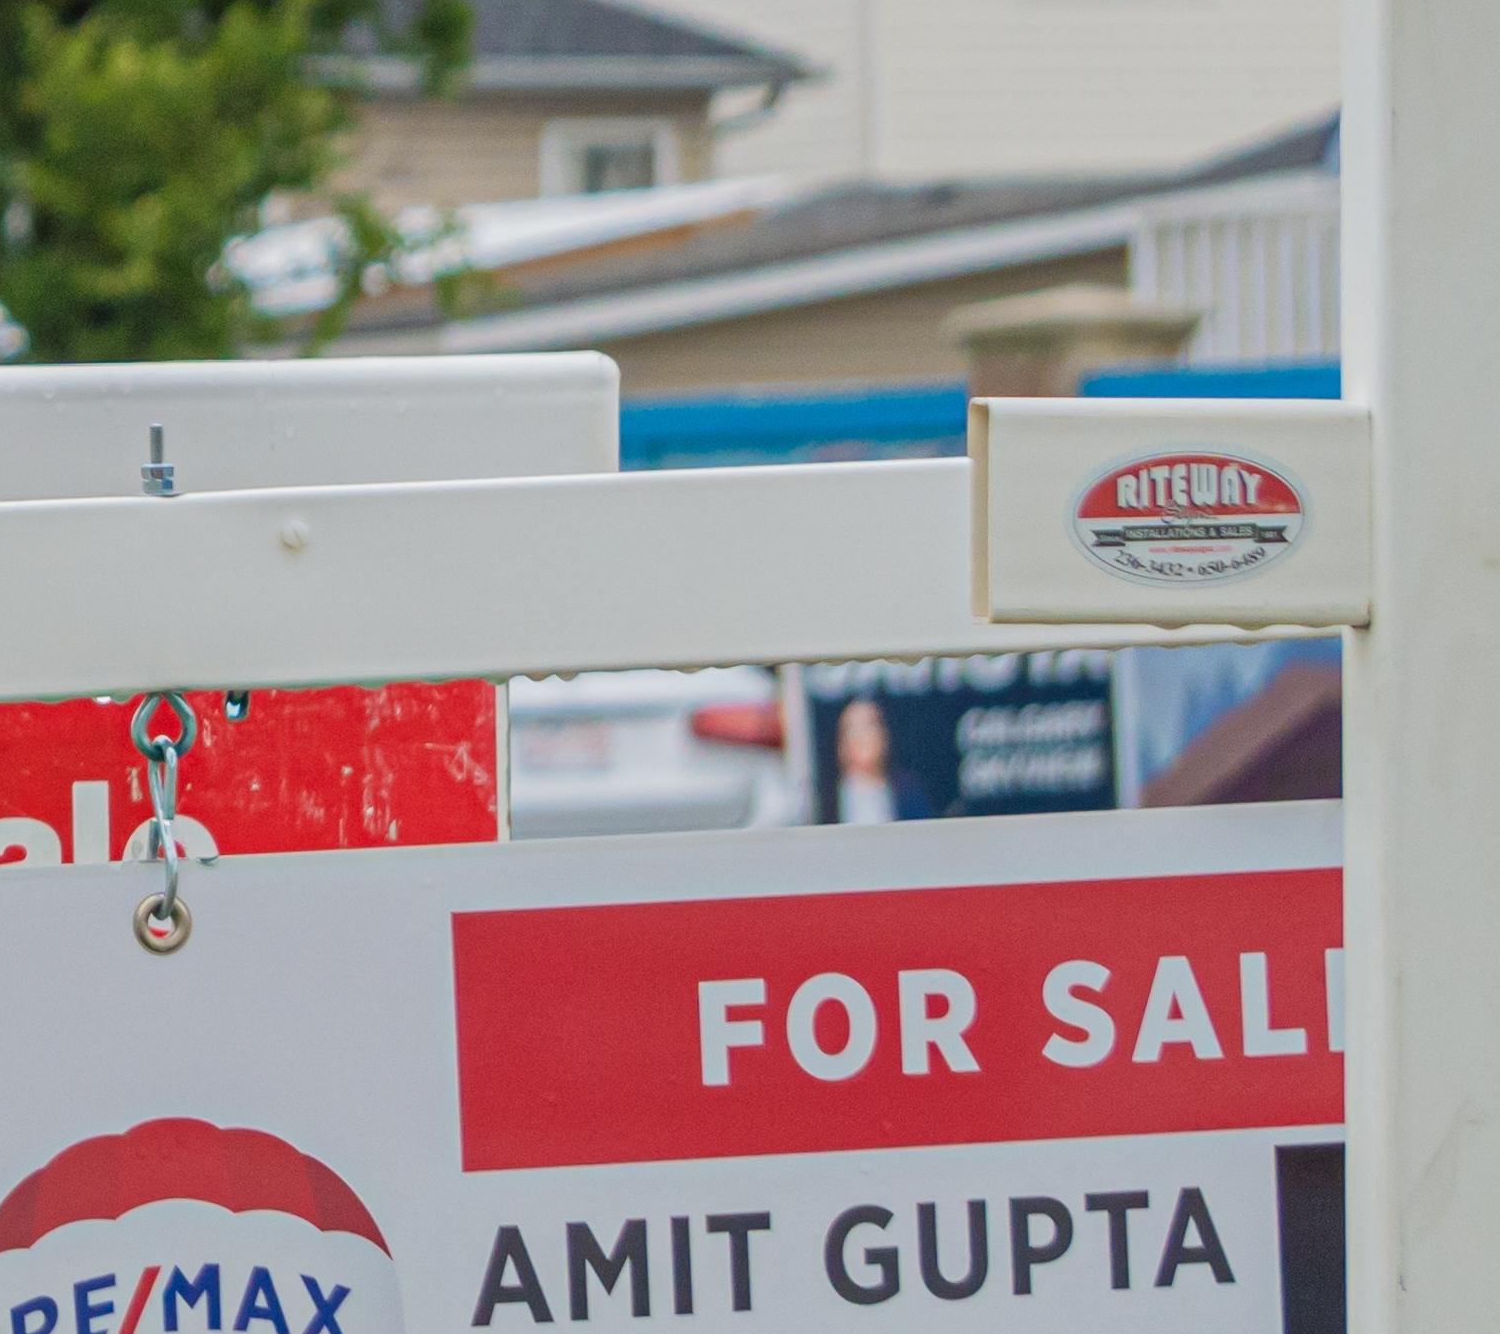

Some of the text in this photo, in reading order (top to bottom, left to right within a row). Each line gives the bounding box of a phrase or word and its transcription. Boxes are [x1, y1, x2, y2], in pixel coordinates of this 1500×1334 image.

[1116, 463, 1261, 510] RITEWAY
[699, 968, 981, 1087] FOR
[471, 1186, 1237, 1326] AMIT GUPTA
